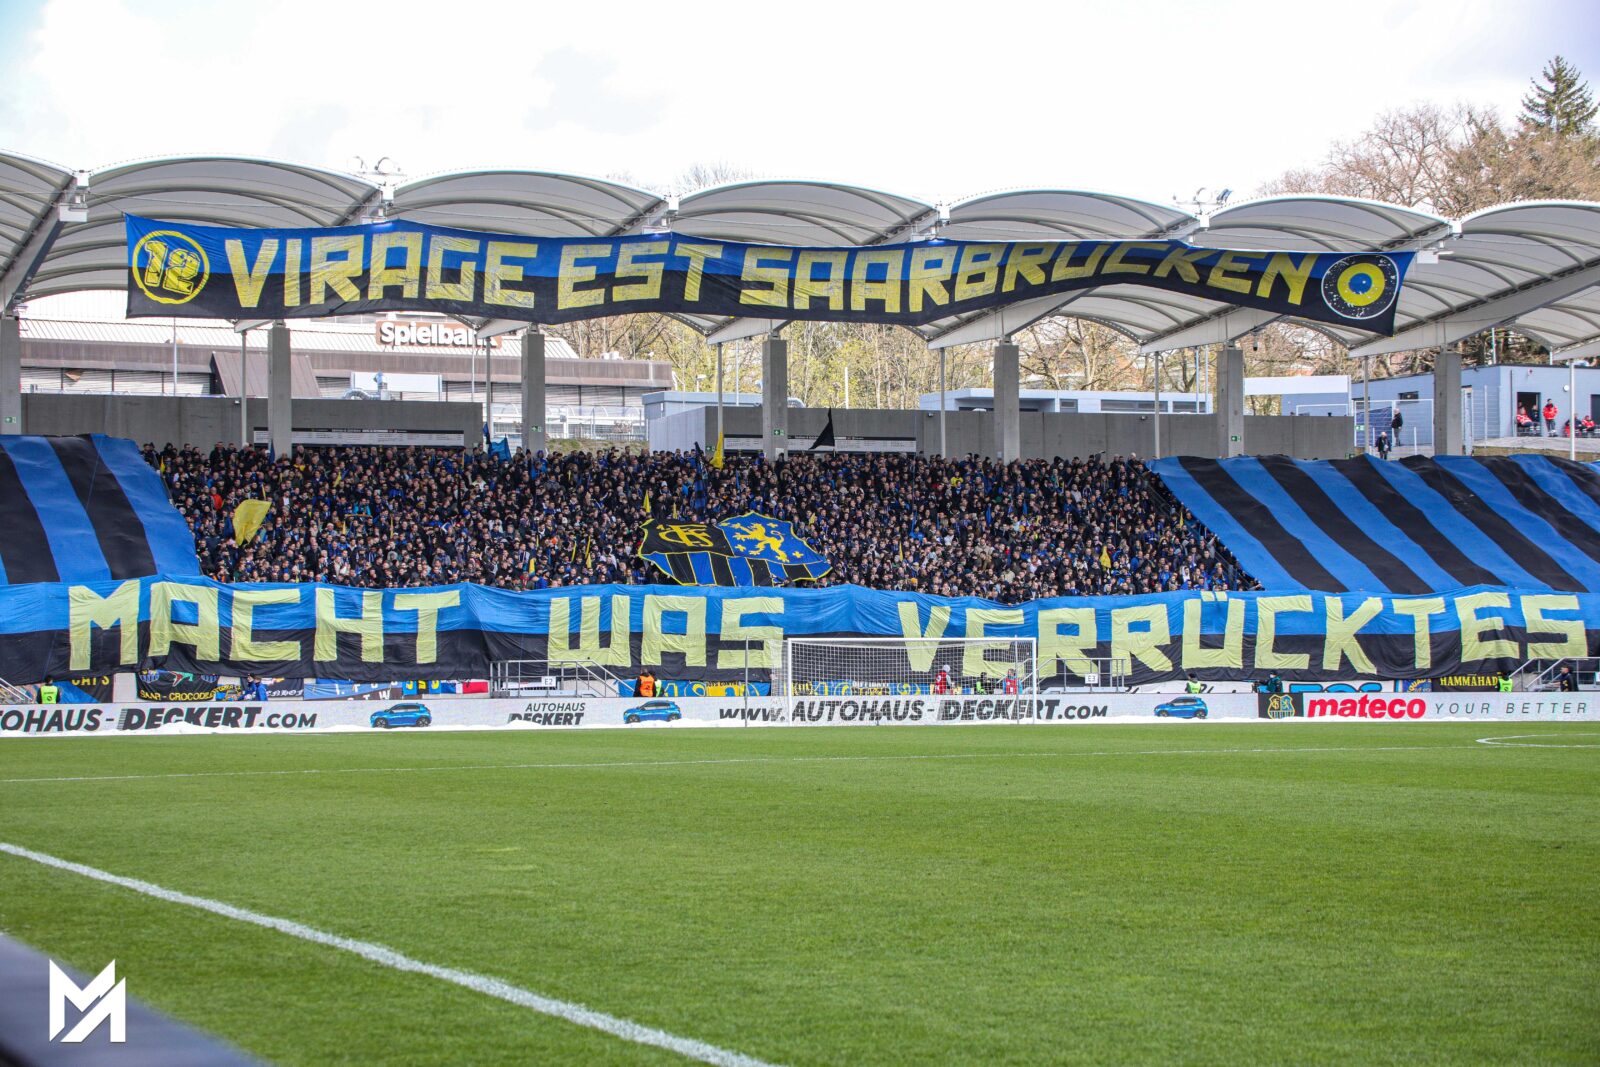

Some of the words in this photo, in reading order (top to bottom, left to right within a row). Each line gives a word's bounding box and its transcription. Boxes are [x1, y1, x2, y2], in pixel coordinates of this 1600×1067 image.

[224, 231, 537, 310] VIRAGE
[557, 241, 723, 310] EST
[68, 579, 461, 671] MACHT
[548, 593, 785, 669] WAS
[897, 590, 1588, 676] VERRÜCKTES
[525, 702, 586, 712] AUTOHAUS
[1307, 693, 1427, 719] mateco
[1435, 702, 1491, 714] YOUR
[1506, 702, 1588, 714] BETTER
